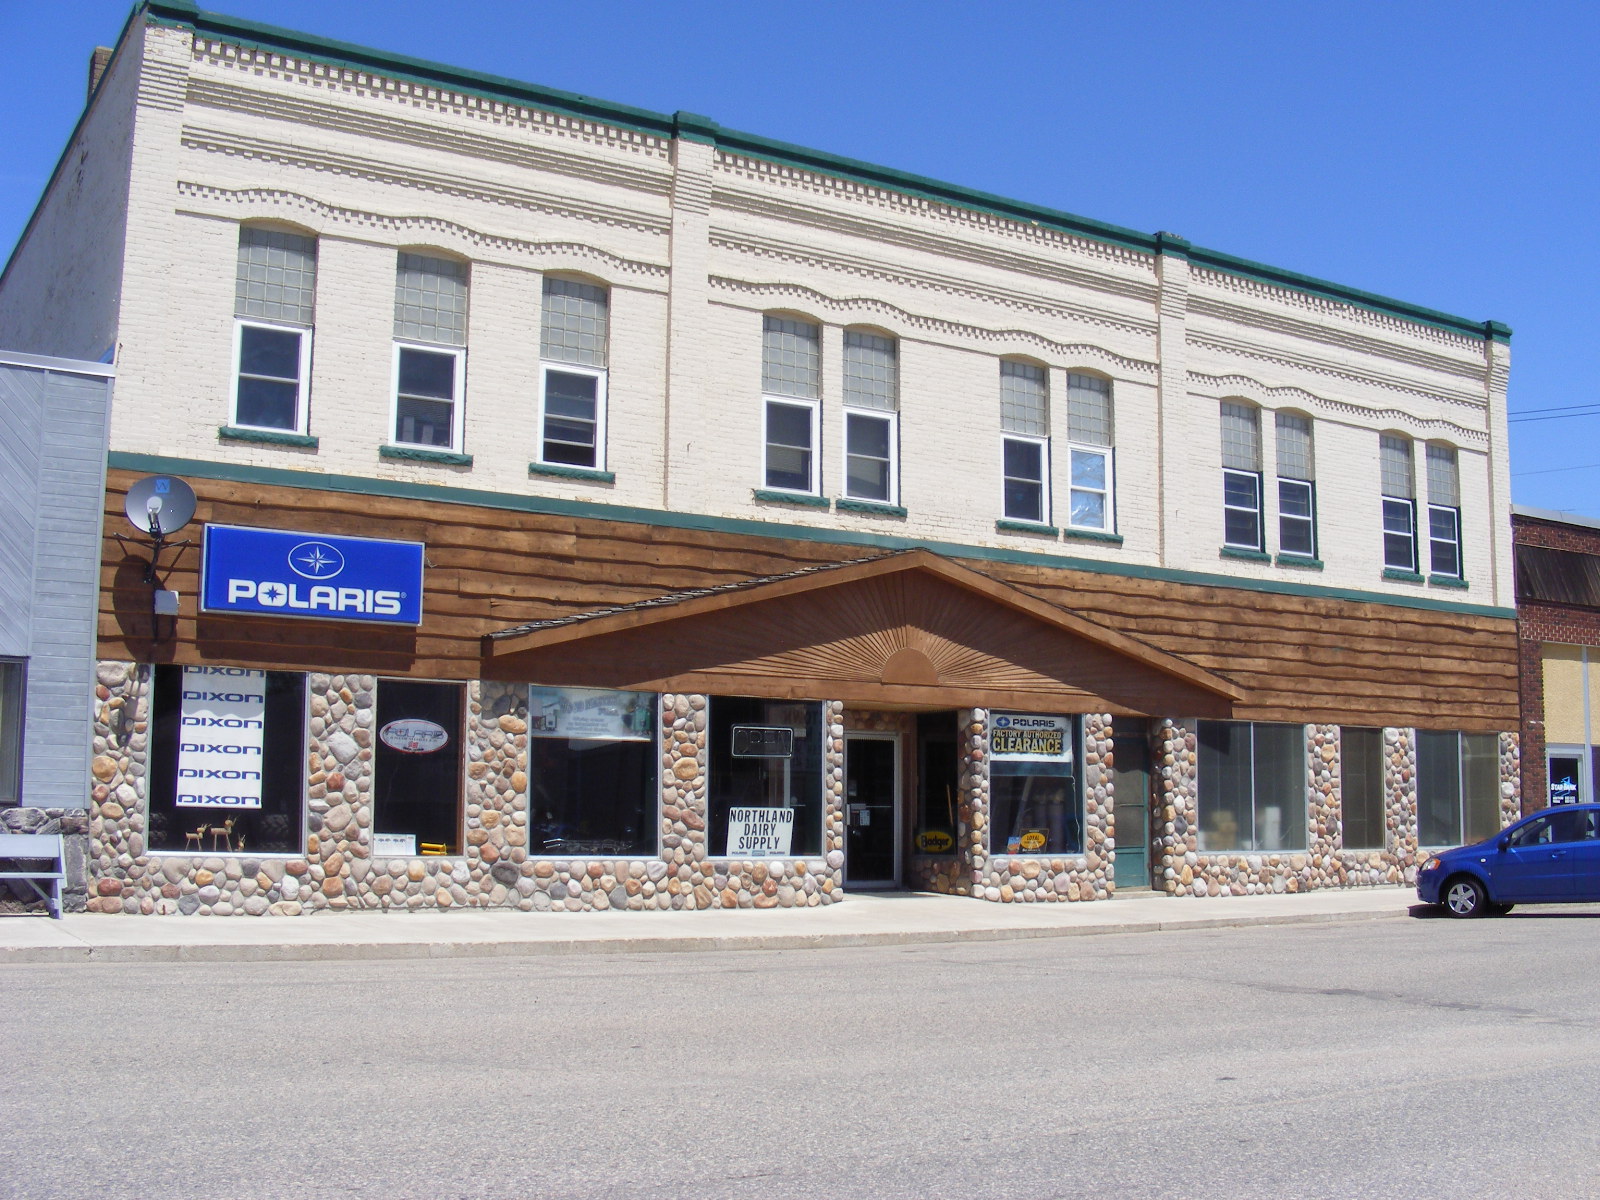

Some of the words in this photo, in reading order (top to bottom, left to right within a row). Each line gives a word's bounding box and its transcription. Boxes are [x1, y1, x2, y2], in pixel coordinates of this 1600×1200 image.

[228, 578, 401, 615] POLARIS
[183, 665, 265, 677] DIXON
[183, 691, 263, 703] DIXON
[182, 716, 263, 729] DIXON
[1013, 718, 1055, 728] POLARIS
[993, 729, 1021, 738] FACTORY
[1023, 730, 1062, 739] AUTHORIZED
[180, 743, 261, 755] DIXON
[992, 737, 1062, 753] CLEARANCE
[179, 768, 260, 780] DIXON
[177, 794, 259, 805] DIXON
[730, 809, 793, 823] NORTHLAND
[744, 823, 776, 836] DAIRY
[738, 836, 780, 850] SUPPLY
[920, 834, 950, 849] Badger
